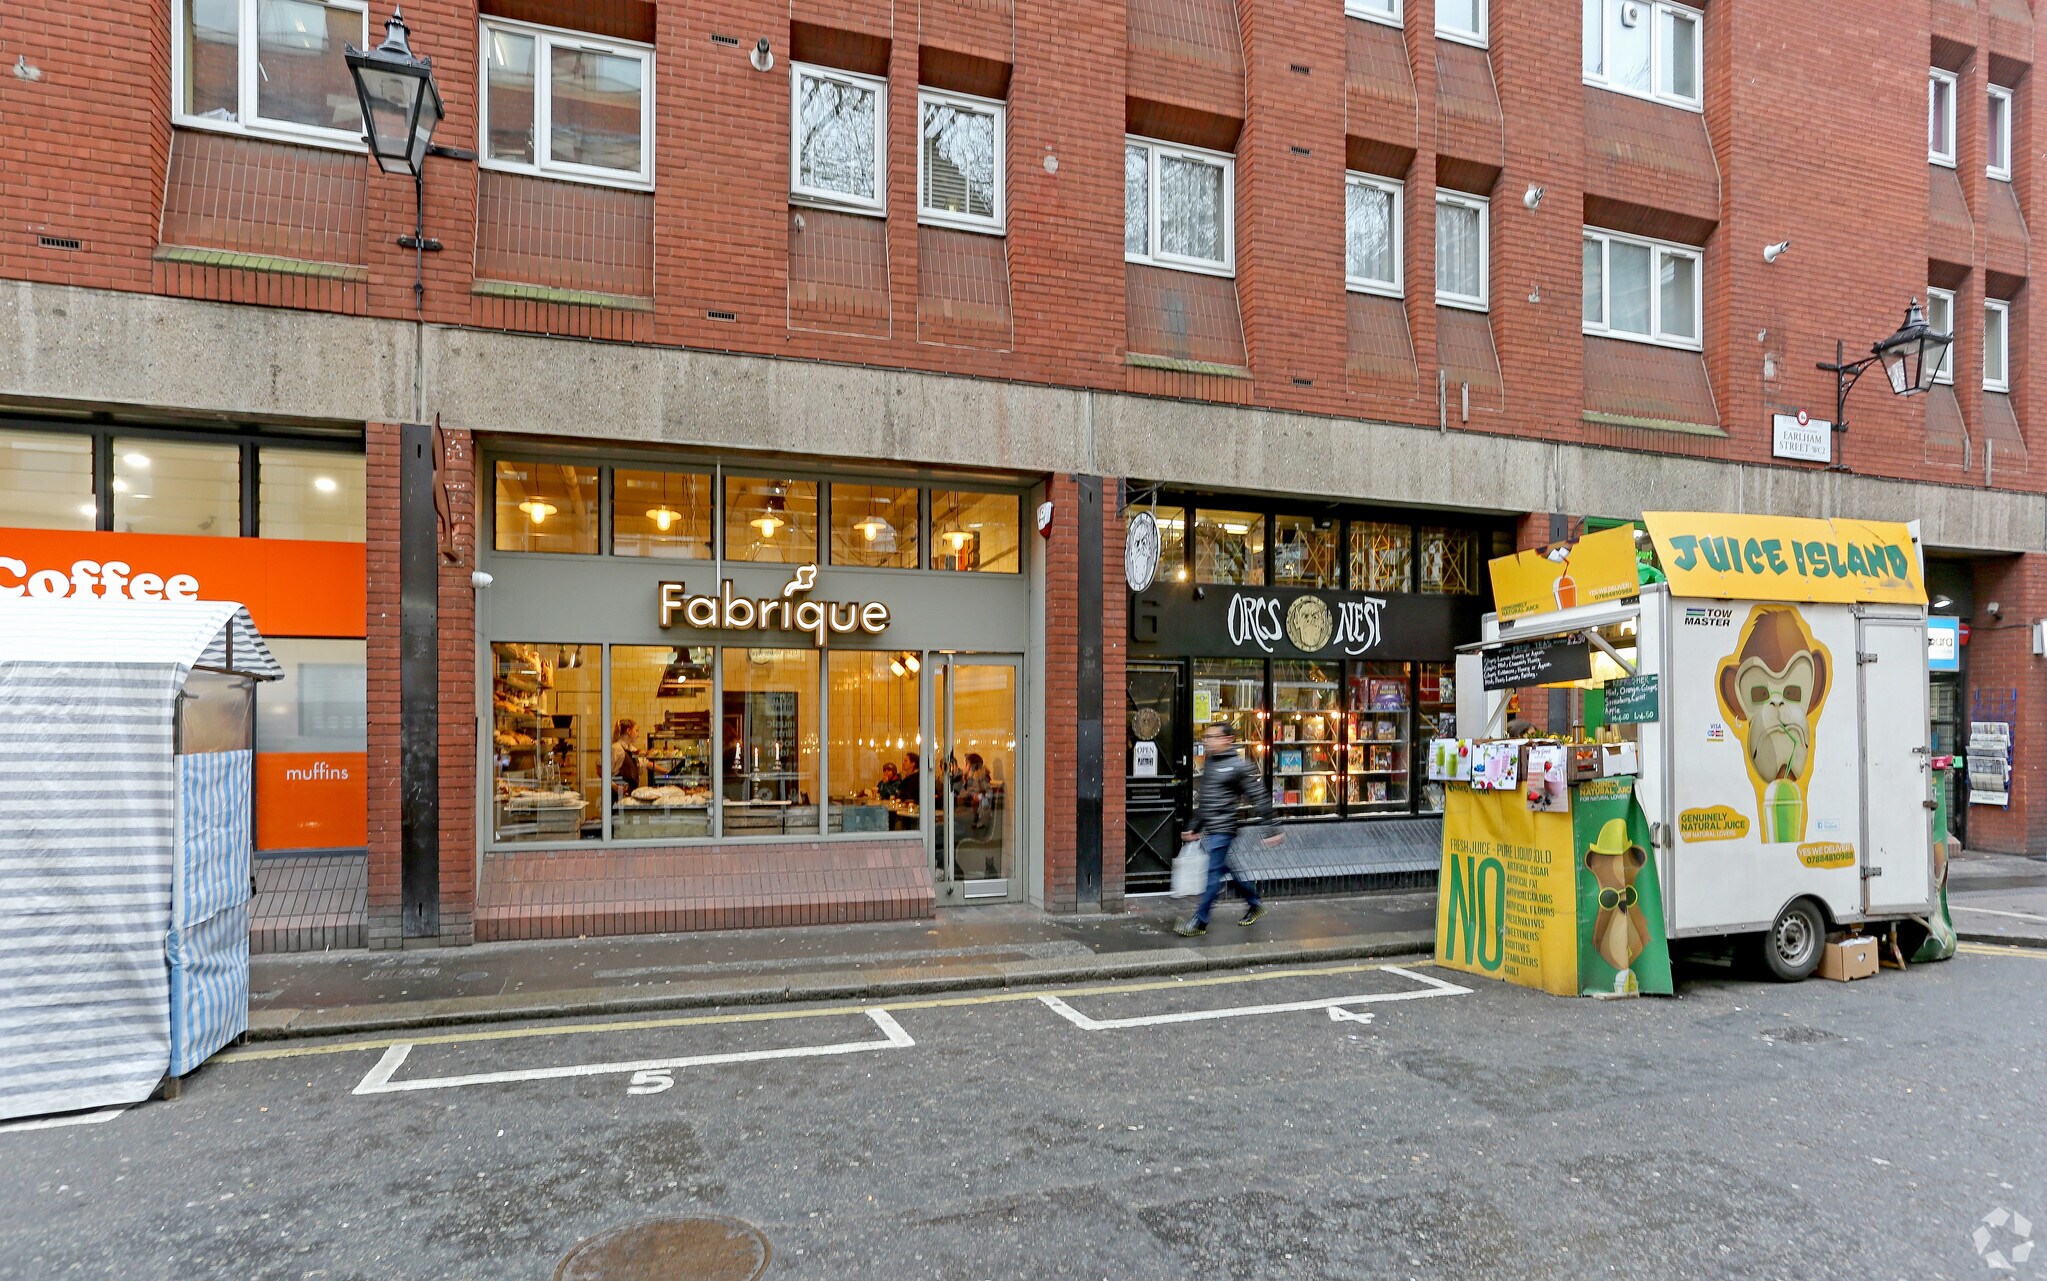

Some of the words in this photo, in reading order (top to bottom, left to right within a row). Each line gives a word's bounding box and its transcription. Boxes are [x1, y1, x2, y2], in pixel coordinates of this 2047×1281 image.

[1783, 431, 1822, 444] EARLHAM
[1779, 441, 1810, 453] STREET
[1811, 446, 1826, 454] WC2
[1669, 534, 1789, 576] JUICE
[1791, 538, 1908, 580] ISLAND
[658, 564, 891, 648] Fabrique
[1707, 608, 1732, 618] TOW
[1227, 592, 1283, 653] ORCS
[1333, 595, 1387, 656] NEST
[1684, 616, 1730, 627] MASTER
[1136, 746, 1154, 754] OPEN
[286, 761, 349, 780] muffins
[1681, 813, 1728, 822] GENUINELY
[1681, 822, 1722, 832] NATURAL
[1723, 820, 1746, 830] JUICE
[1450, 838, 1468, 853] FRESH
[1470, 840, 1490, 856] JUICE
[1496, 844, 1514, 859] PURE
[1514, 846, 1532, 862] LIQUID
[1798, 847, 1812, 856] YES
[1812, 846, 1823, 855] WE
[1529, 880, 1538, 890] FAT
[1446, 853, 1505, 971] NO
[1506, 926, 1540, 941] SWEETENERS
[1505, 940, 1530, 953] ADDITIVES
[1504, 952, 1538, 968] STABILIZERS
[1504, 965, 1519, 976] GUILT
[1326, 1006, 1375, 1024] 4
[626, 1068, 675, 1096] 5
